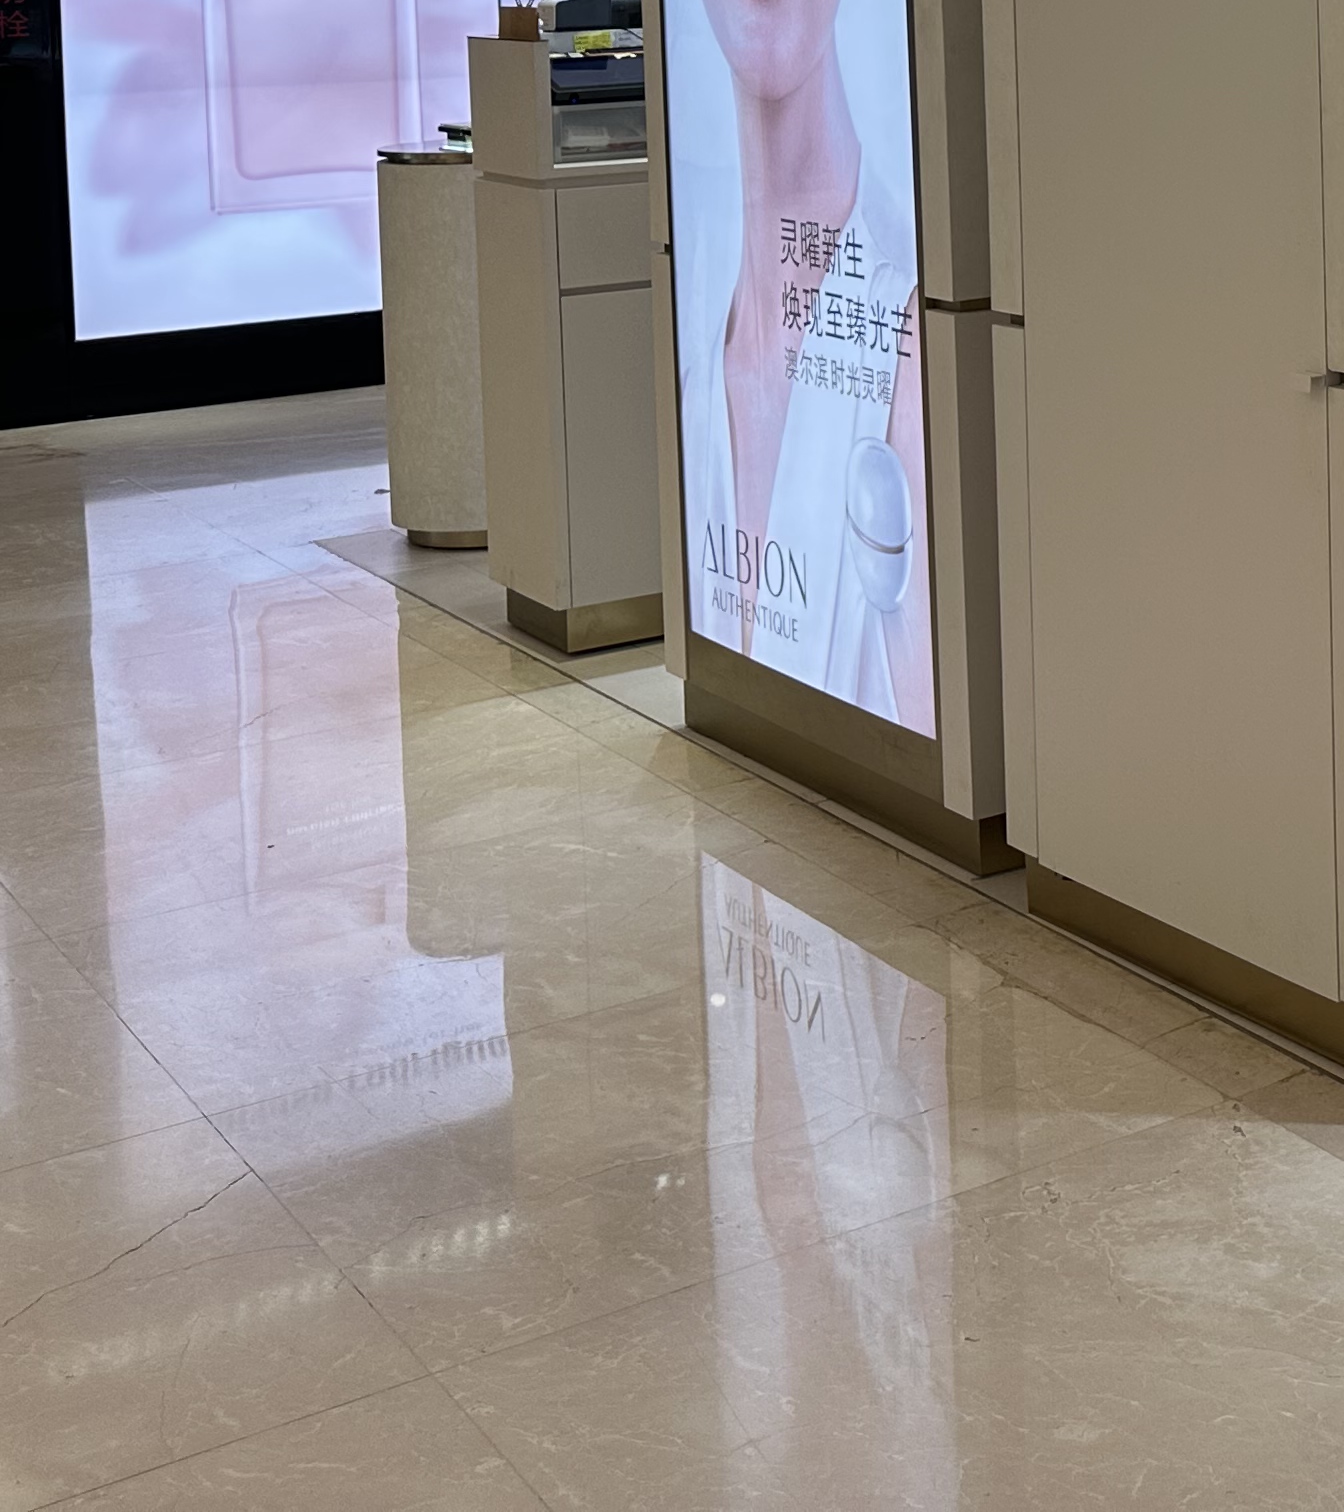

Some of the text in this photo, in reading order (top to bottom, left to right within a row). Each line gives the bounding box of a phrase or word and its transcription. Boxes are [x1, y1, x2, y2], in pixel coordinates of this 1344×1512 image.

[780, 217, 866, 280] 灵曜新生
[782, 280, 913, 358] 焕现至臻光芒
[784, 346, 892, 407] 澳尔滨时光灵曜
[701, 518, 808, 609] ALBION
[712, 586, 799, 643] AUTHENTIQUE
